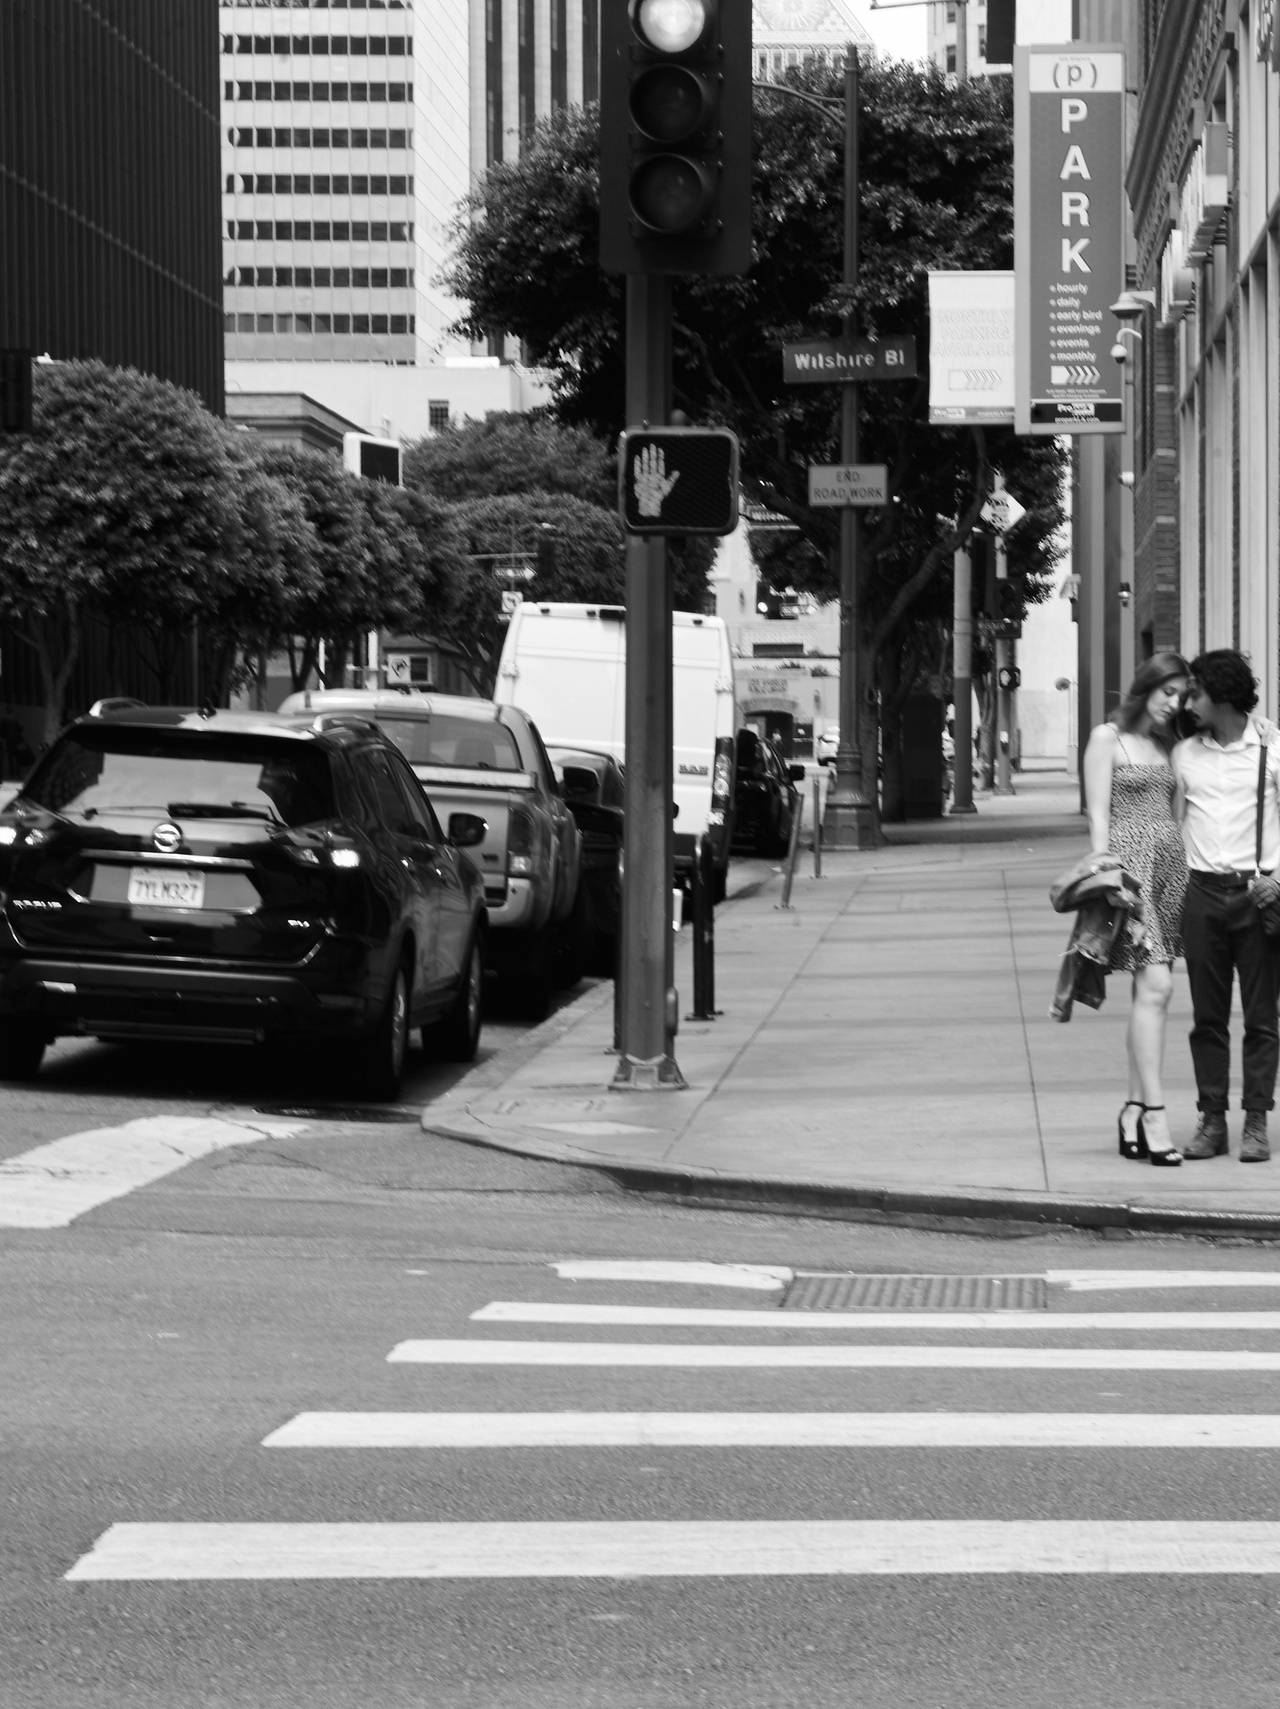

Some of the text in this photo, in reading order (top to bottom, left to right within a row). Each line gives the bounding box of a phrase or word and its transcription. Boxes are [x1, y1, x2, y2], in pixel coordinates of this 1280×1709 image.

[1060, 98, 1092, 273] PARK
[1056, 283, 1088, 295] hourly
[1056, 297, 1081, 309] daily
[938, 309, 1011, 324] MONTHLY
[1056, 310, 1103, 322] early bird
[940, 325, 1011, 340] PARKING
[1056, 324, 1101, 336] evenings
[1056, 338, 1089, 349] events
[794, 349, 905, 370] Wilshire Bl
[1056, 351, 1096, 363] monthly
[836, 471, 861, 483] END
[813, 486, 884, 499] ROAD WORK
